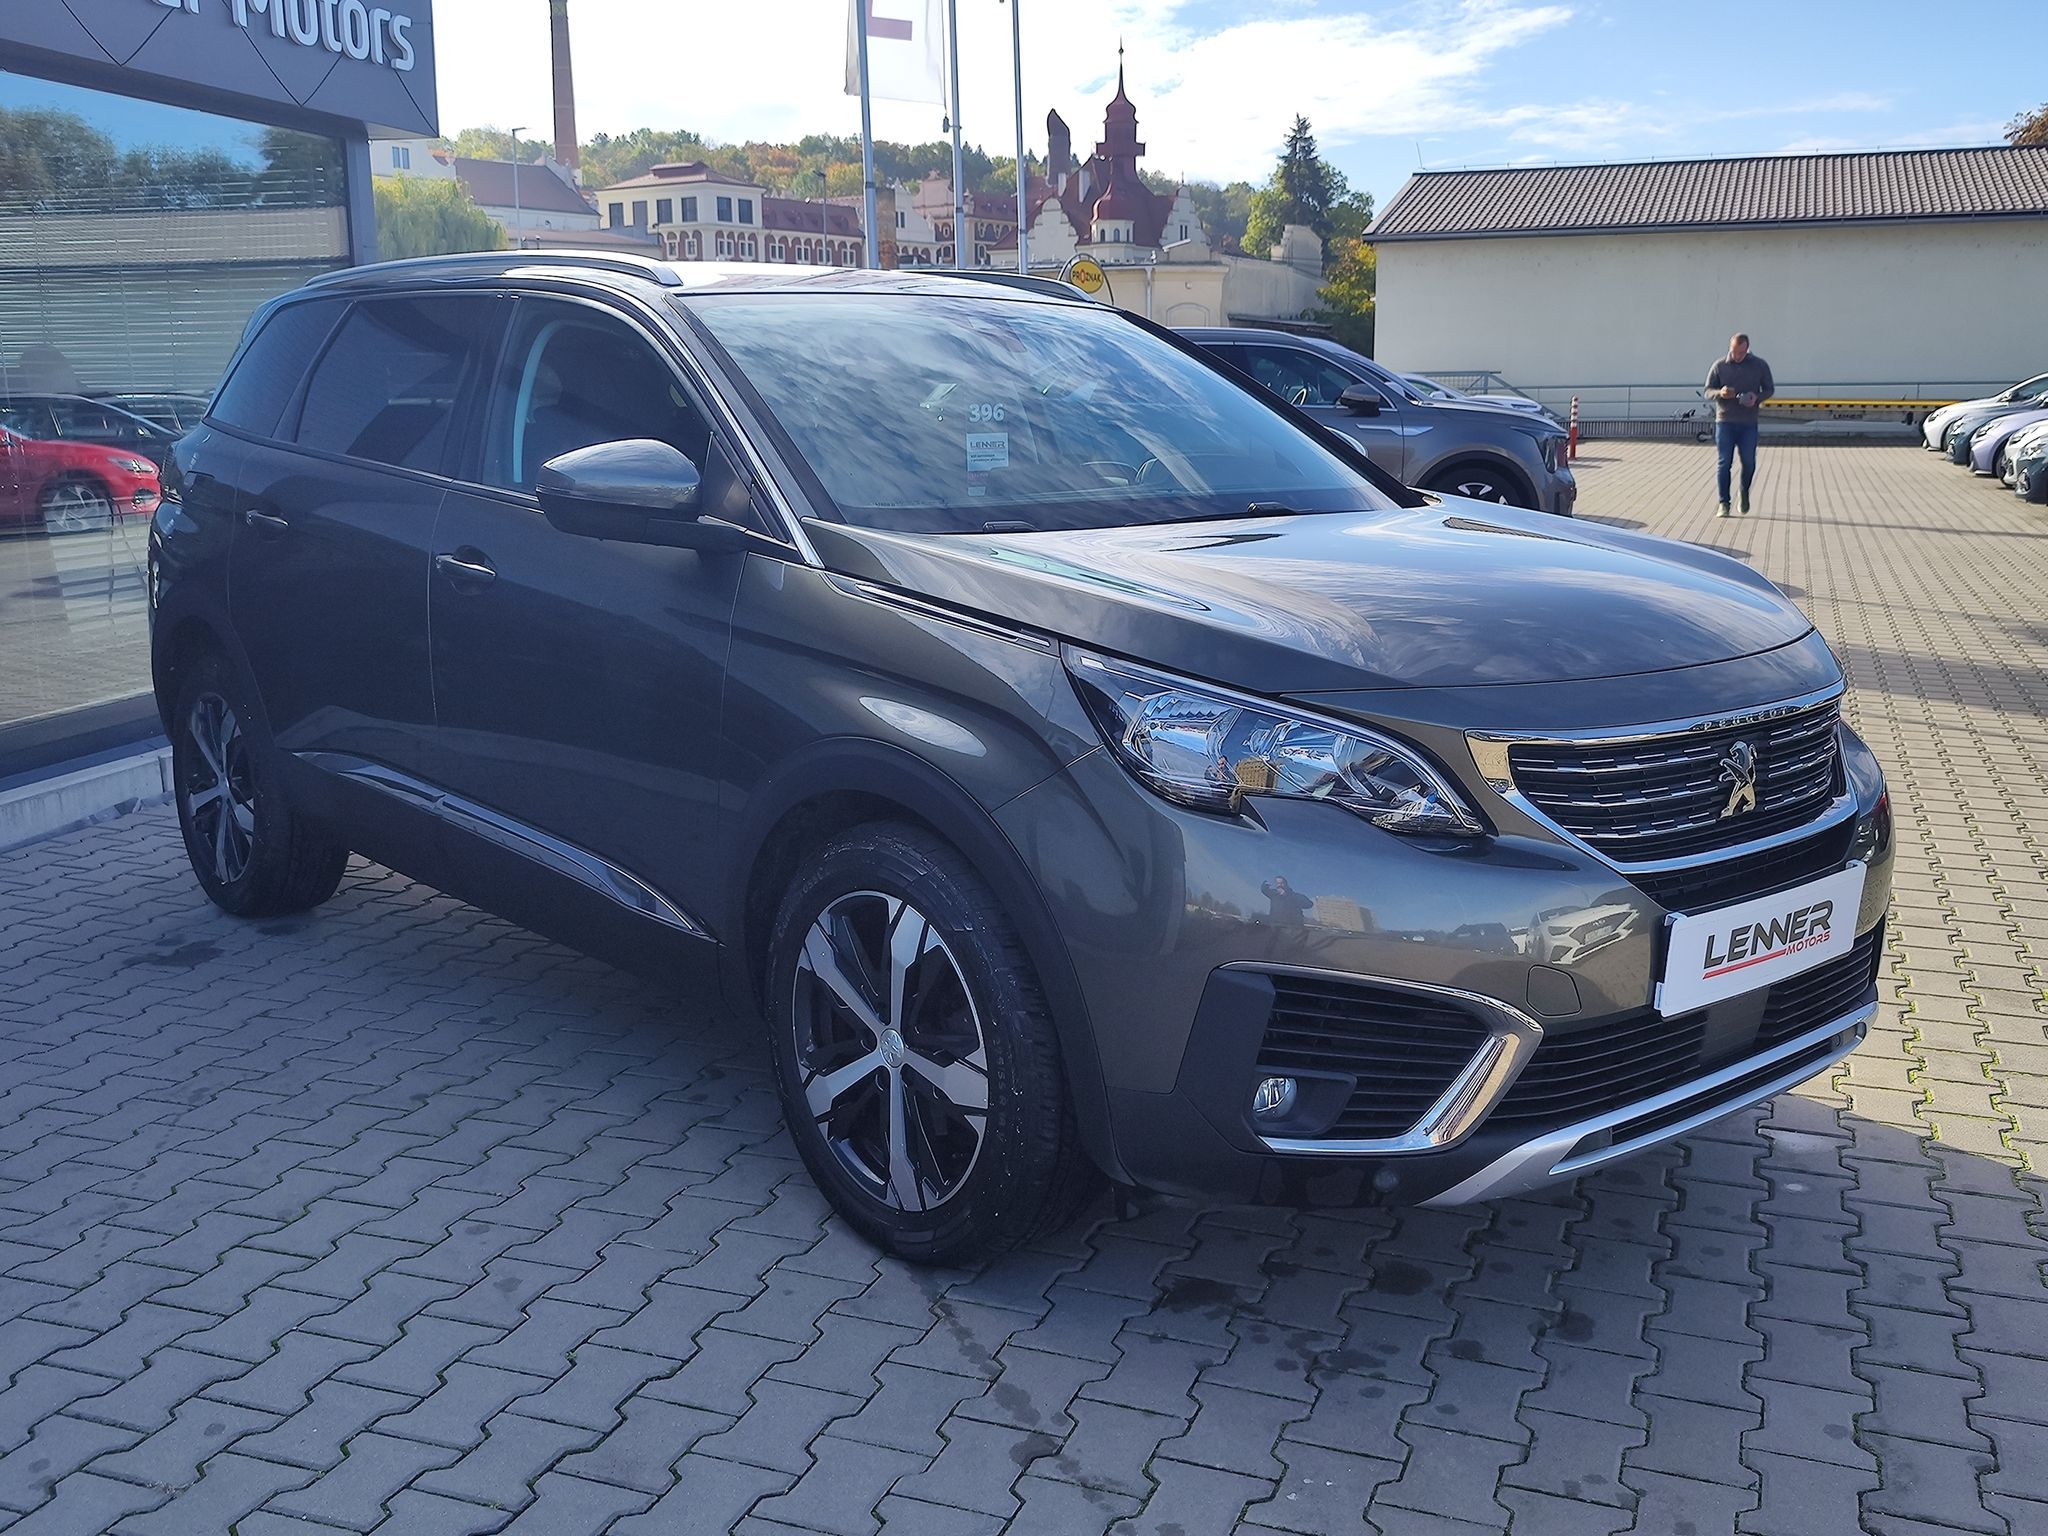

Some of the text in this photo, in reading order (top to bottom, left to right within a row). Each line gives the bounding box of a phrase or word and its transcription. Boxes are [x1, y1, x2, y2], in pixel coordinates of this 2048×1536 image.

[969, 403, 1005, 422] 396
[1703, 900, 1833, 970] LENNER
[1785, 931, 1830, 956] MOTORS
